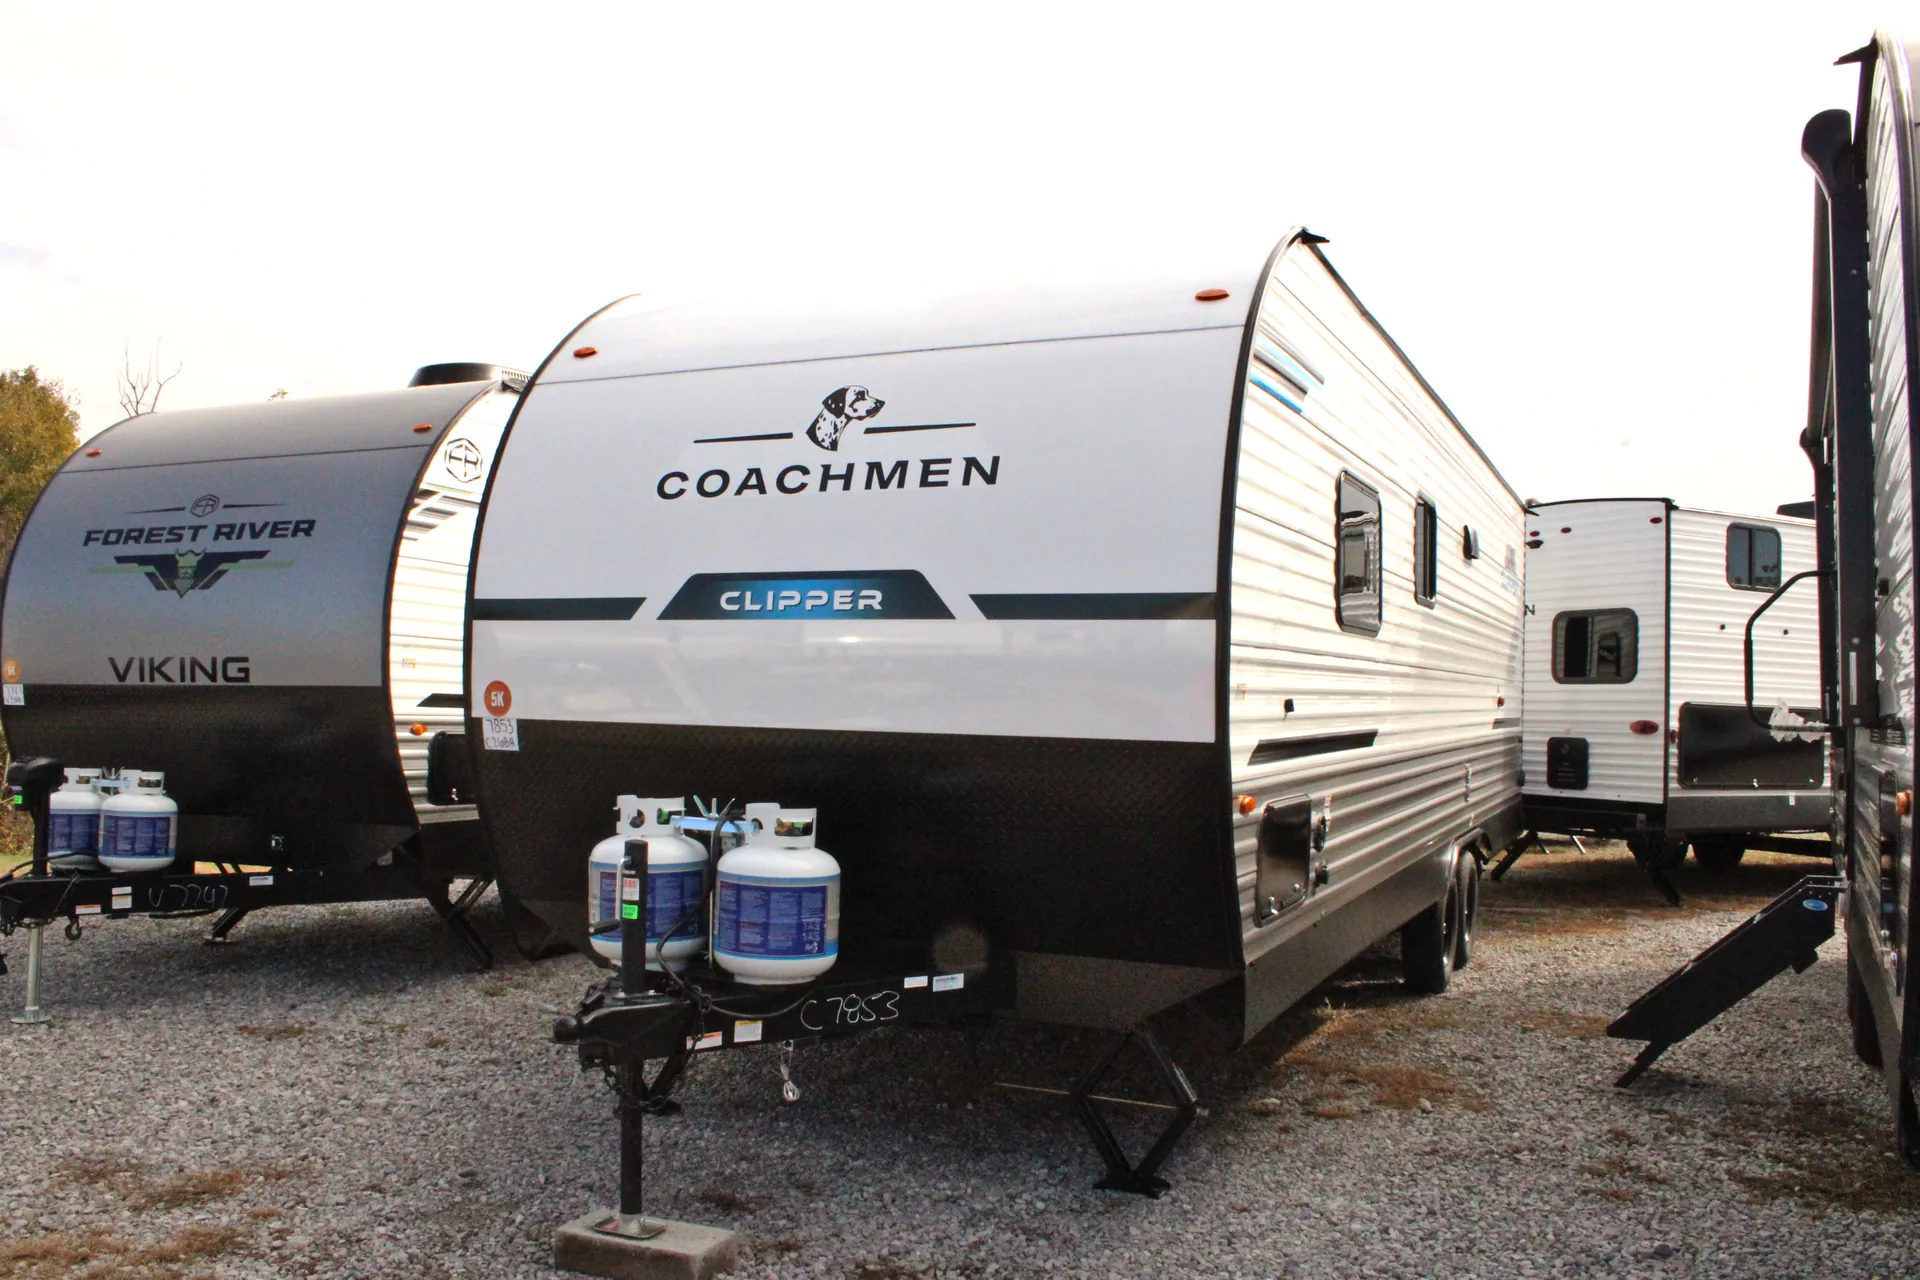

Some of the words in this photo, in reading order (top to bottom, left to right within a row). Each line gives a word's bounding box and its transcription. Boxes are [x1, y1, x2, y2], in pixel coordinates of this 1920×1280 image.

[656, 455, 1001, 500] COACHMEN
[82, 524, 208, 547] FOREST
[212, 519, 317, 541] RIVER
[719, 590, 884, 612] CLIPPER
[108, 656, 251, 683] VIKING
[491, 691, 505, 707] 5K
[486, 718, 515, 735] 7853
